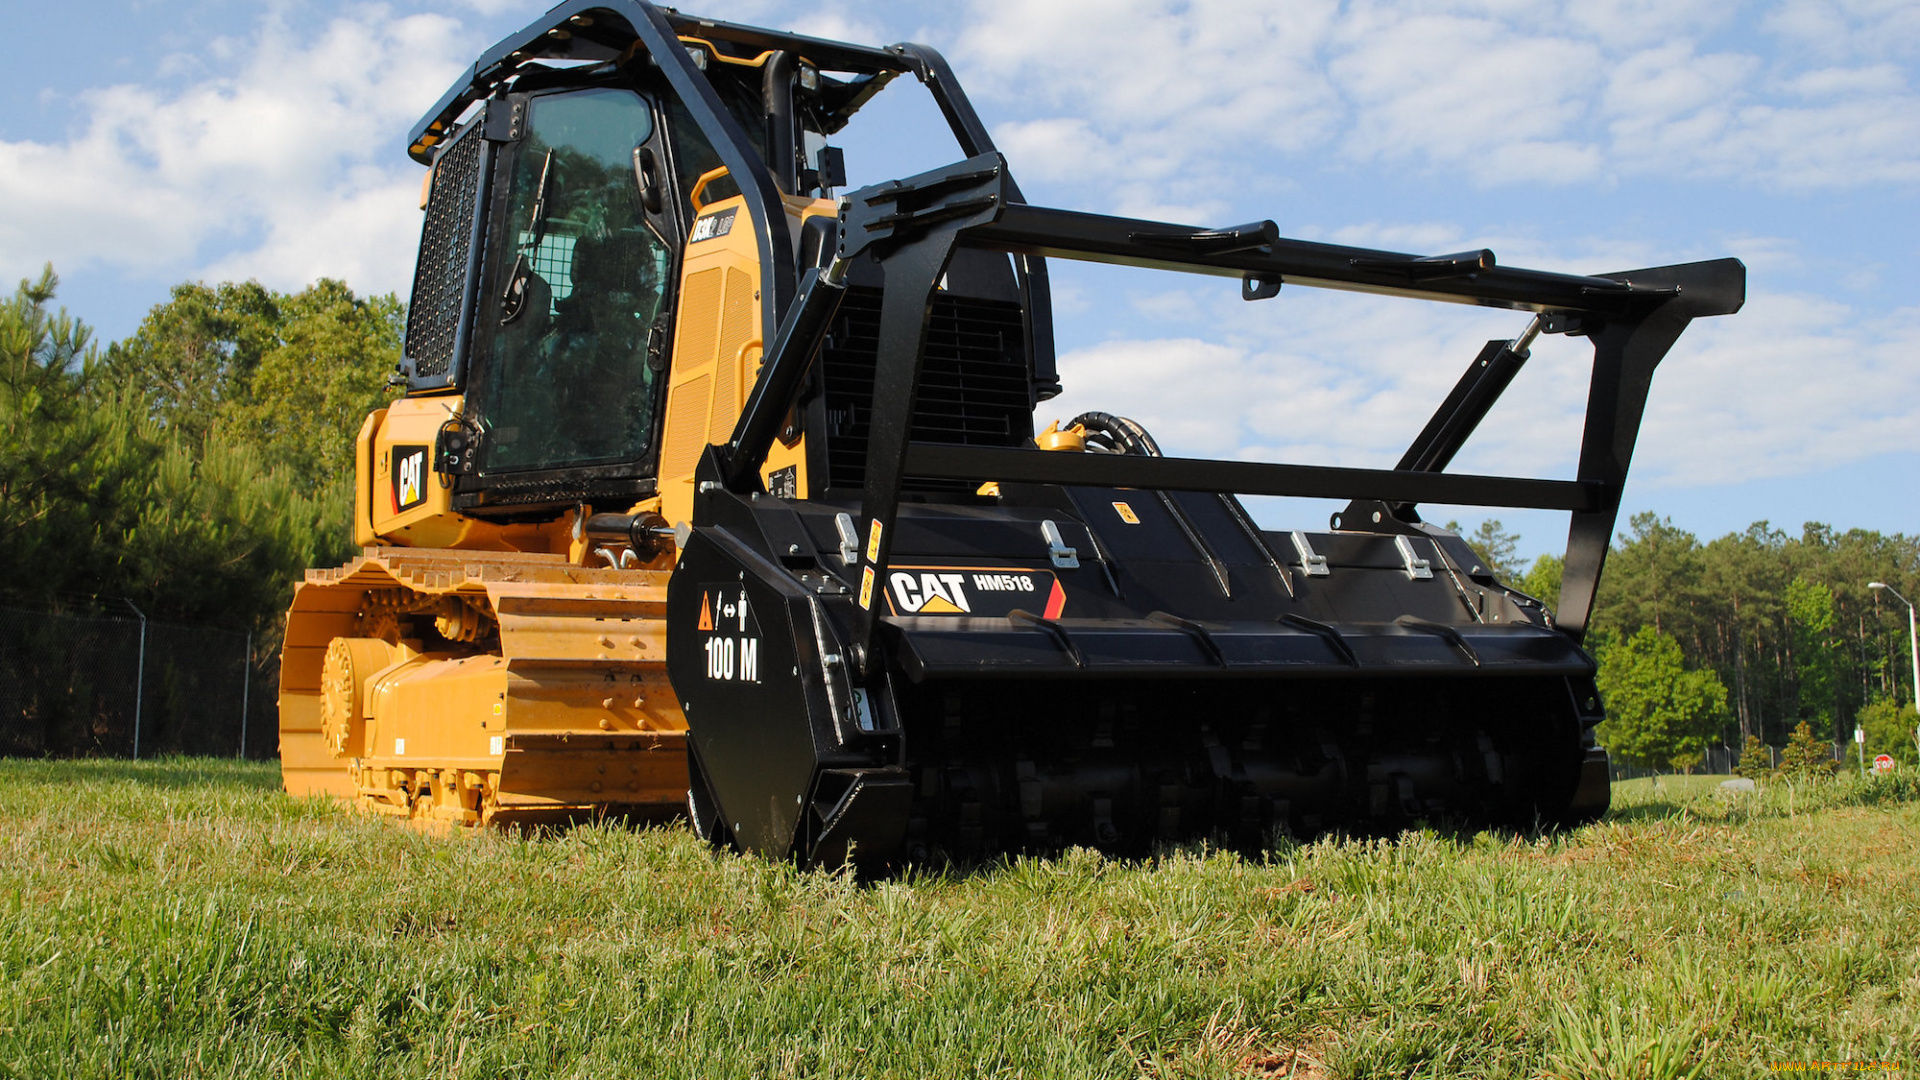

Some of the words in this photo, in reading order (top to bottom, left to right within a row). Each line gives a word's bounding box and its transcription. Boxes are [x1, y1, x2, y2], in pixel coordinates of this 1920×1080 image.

[400, 451, 423, 506] CAT
[890, 572, 971, 613] CAT
[973, 574, 1035, 592] HM518
[705, 637, 734, 681] 100
[741, 637, 758, 681] M
